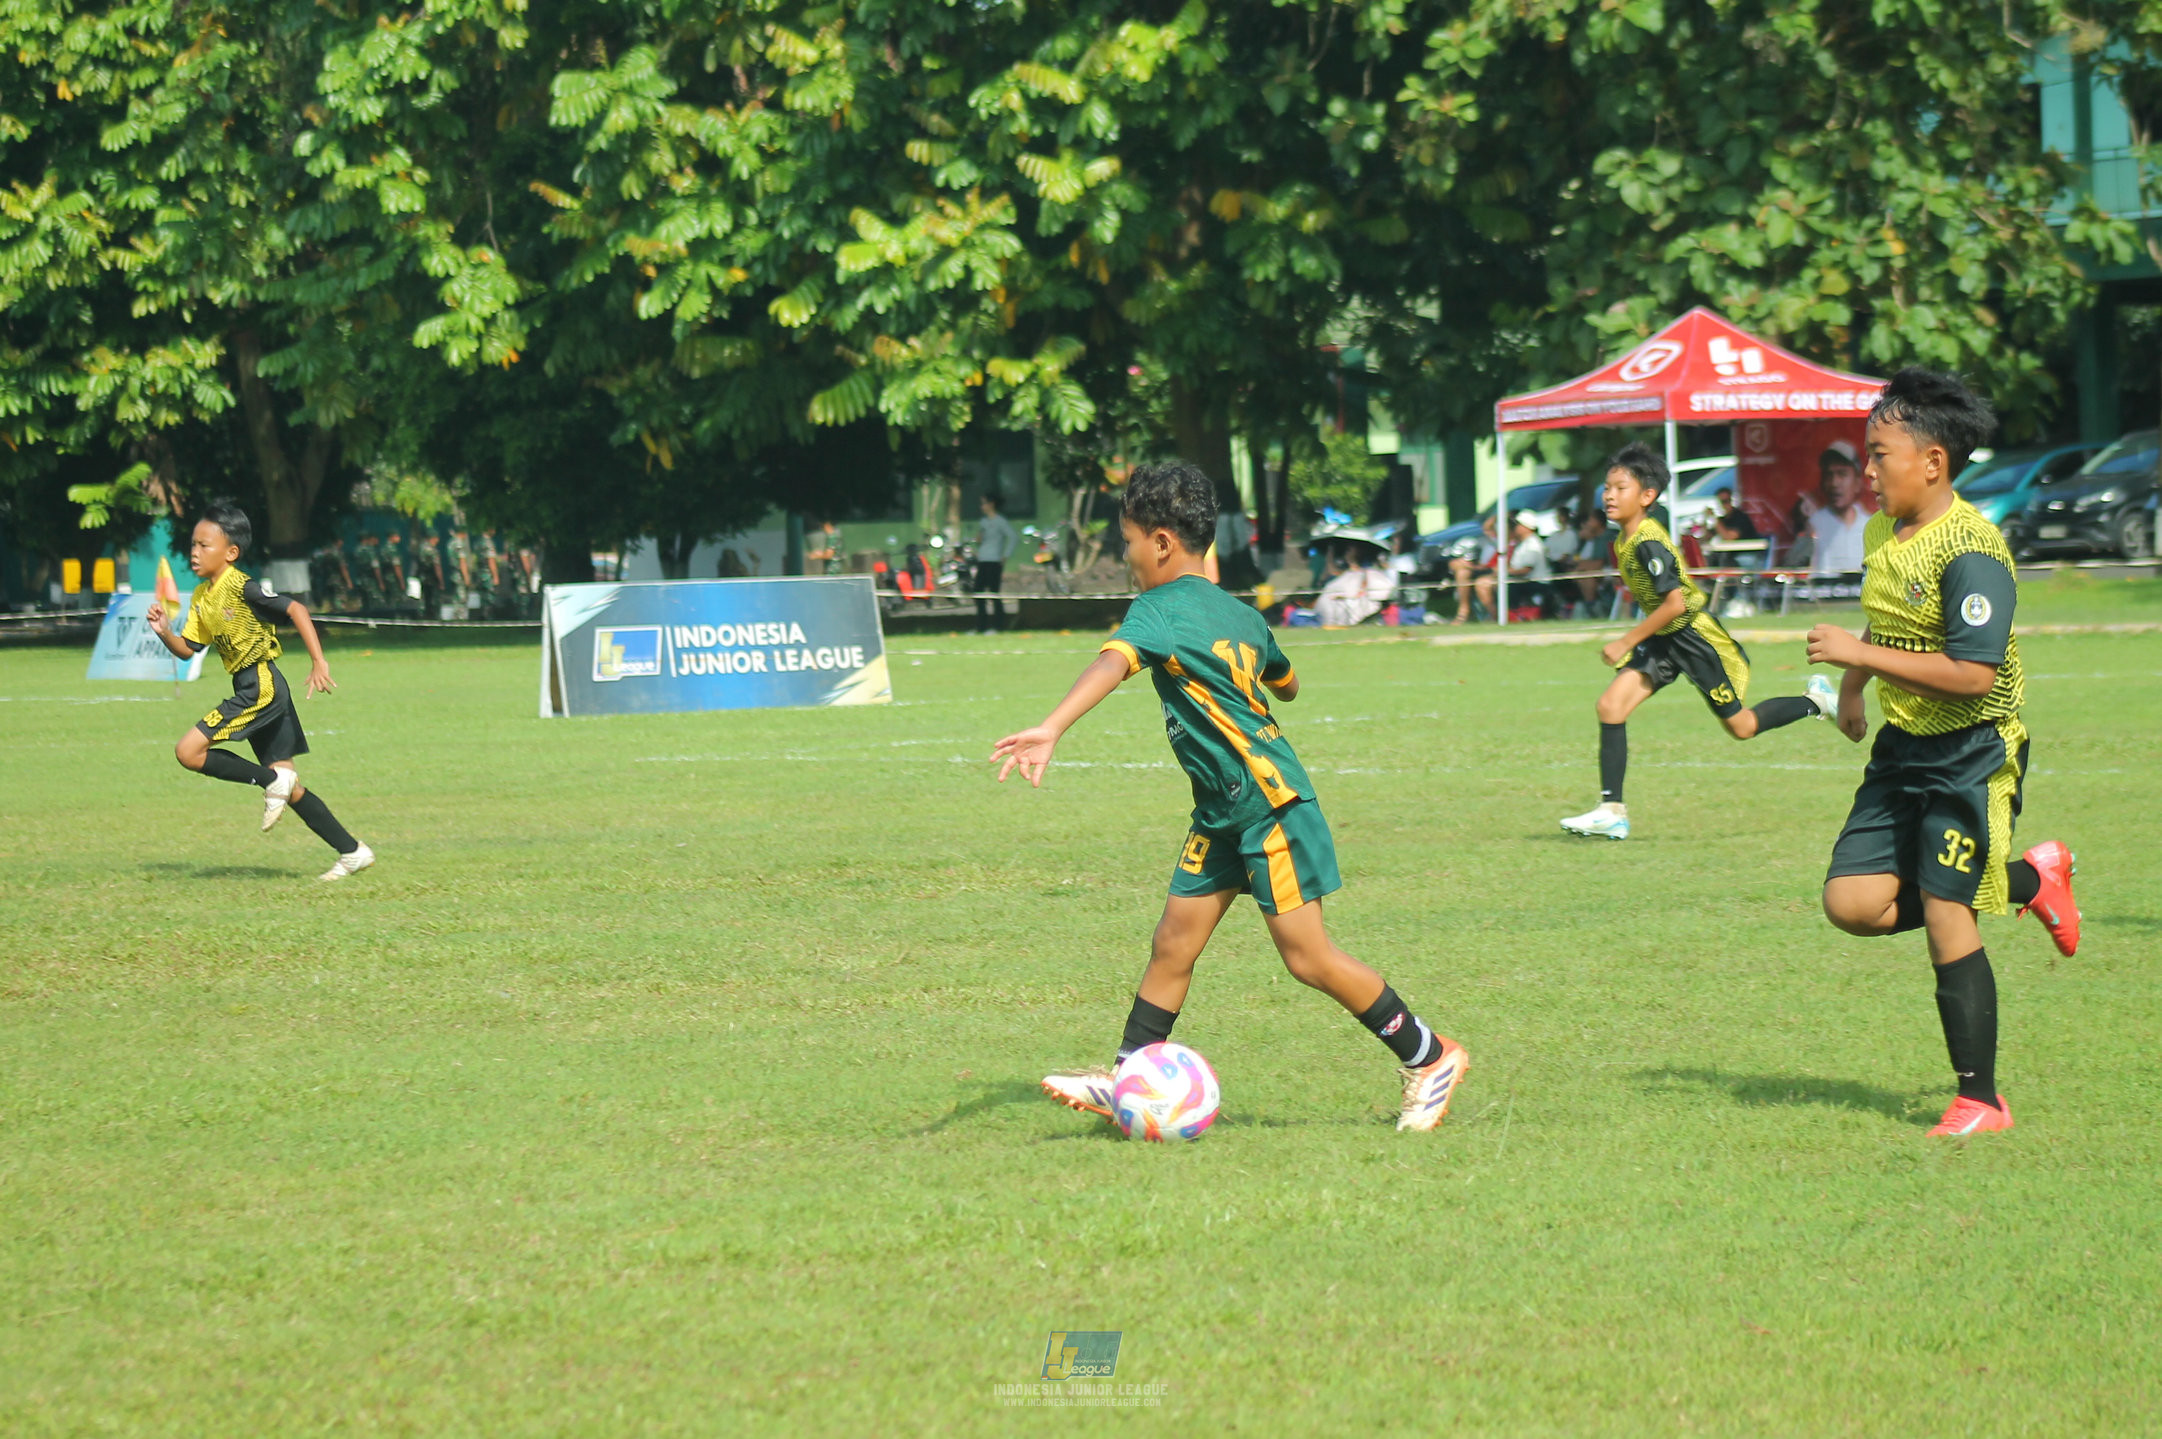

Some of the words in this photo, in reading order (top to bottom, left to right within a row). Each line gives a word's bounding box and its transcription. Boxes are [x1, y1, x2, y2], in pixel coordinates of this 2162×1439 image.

[1690, 391, 1786, 411] STRATEGY
[1788, 392, 1818, 411] ON
[1819, 391, 1854, 411] THE
[674, 622, 806, 649] INDONESIA
[678, 650, 769, 676] JUNIOR
[775, 646, 865, 672] LEAGUE
[1937, 828, 1976, 874] 32
